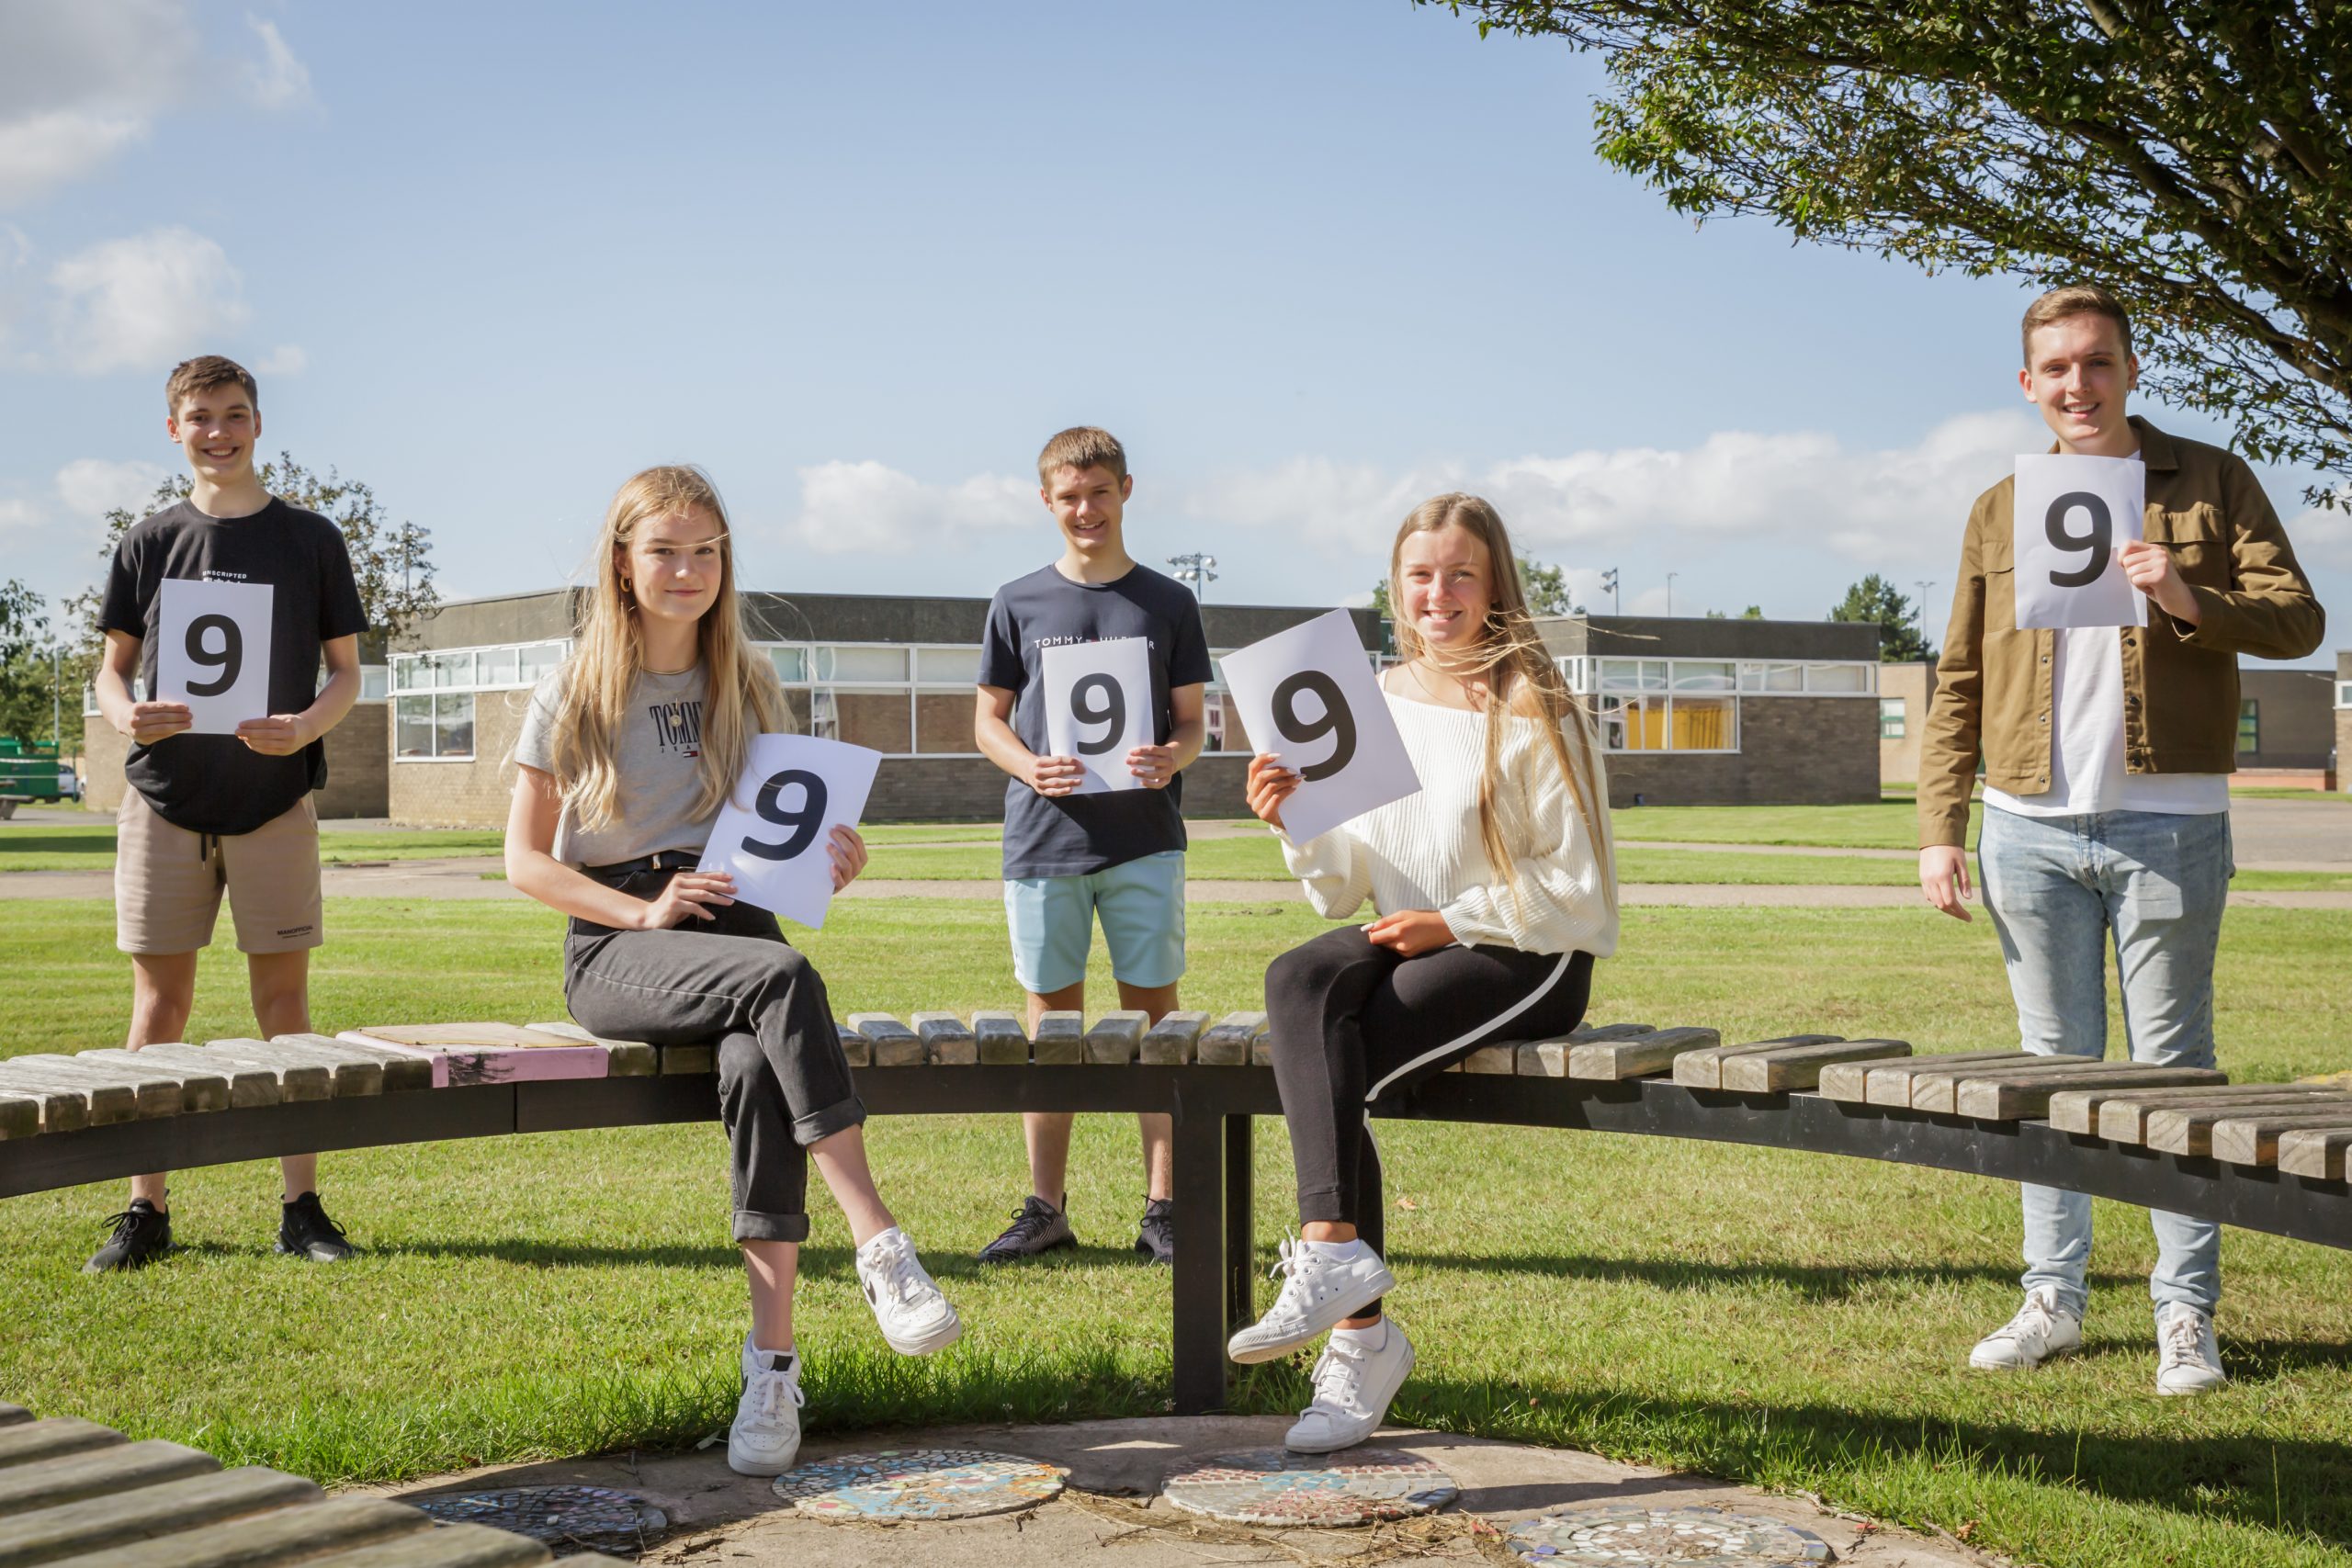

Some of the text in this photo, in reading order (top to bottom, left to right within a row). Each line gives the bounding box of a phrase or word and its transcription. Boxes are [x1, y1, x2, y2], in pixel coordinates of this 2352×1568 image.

[202, 570, 247, 580] UNSCRIPTED
[2044, 491, 2113, 588] 9
[185, 614, 243, 698] 9
[1035, 636, 1082, 649] TOMMY
[1070, 672, 1126, 756] 9
[1272, 670, 1357, 783] 9
[741, 769, 828, 862] 9
